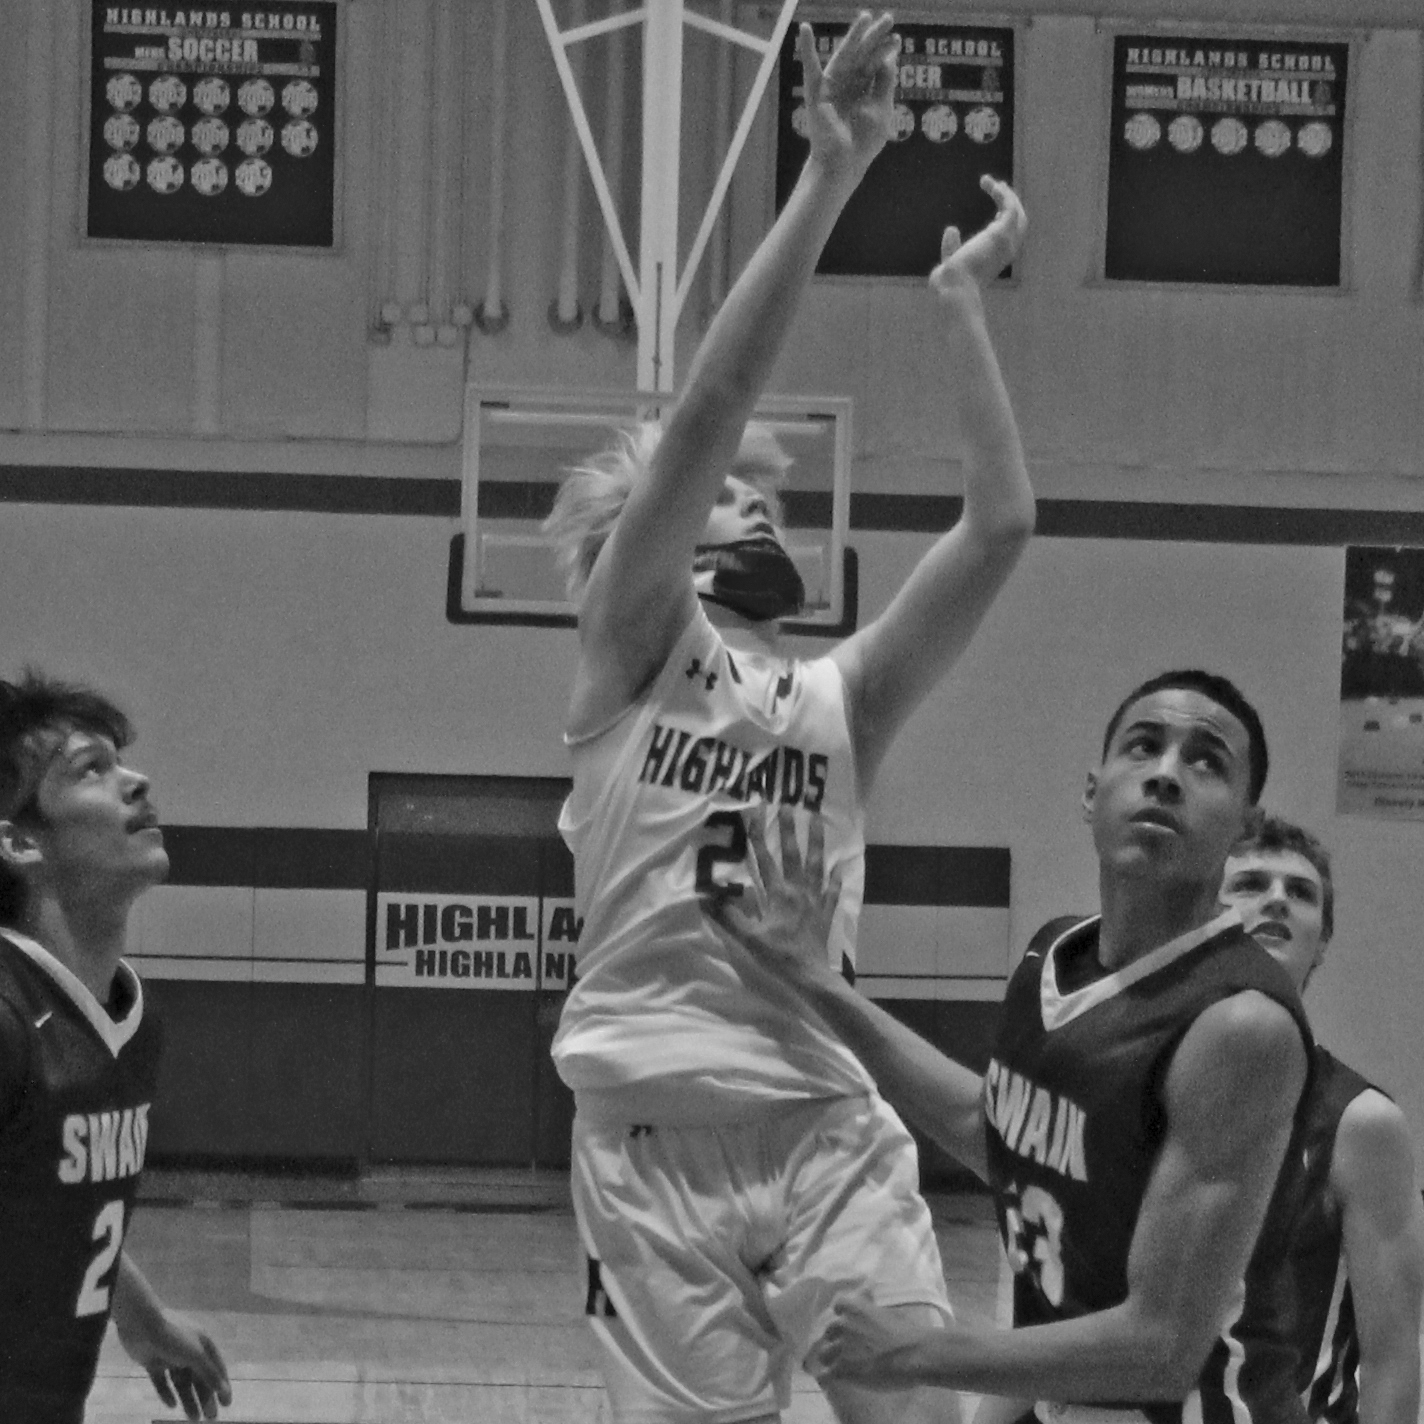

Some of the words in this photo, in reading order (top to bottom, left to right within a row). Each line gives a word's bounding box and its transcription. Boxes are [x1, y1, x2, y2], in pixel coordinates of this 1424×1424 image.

[106, 8, 231, 28] HIGHLANDS
[241, 12, 320, 31] SCHOOL
[167, 37, 258, 63] SOCCER
[925, 37, 1001, 57] SCHOOL
[1127, 48, 1247, 68] HIGHLANDS
[1258, 52, 1334, 71] SCHOOL
[1176, 77, 1311, 104] BASKETBALL
